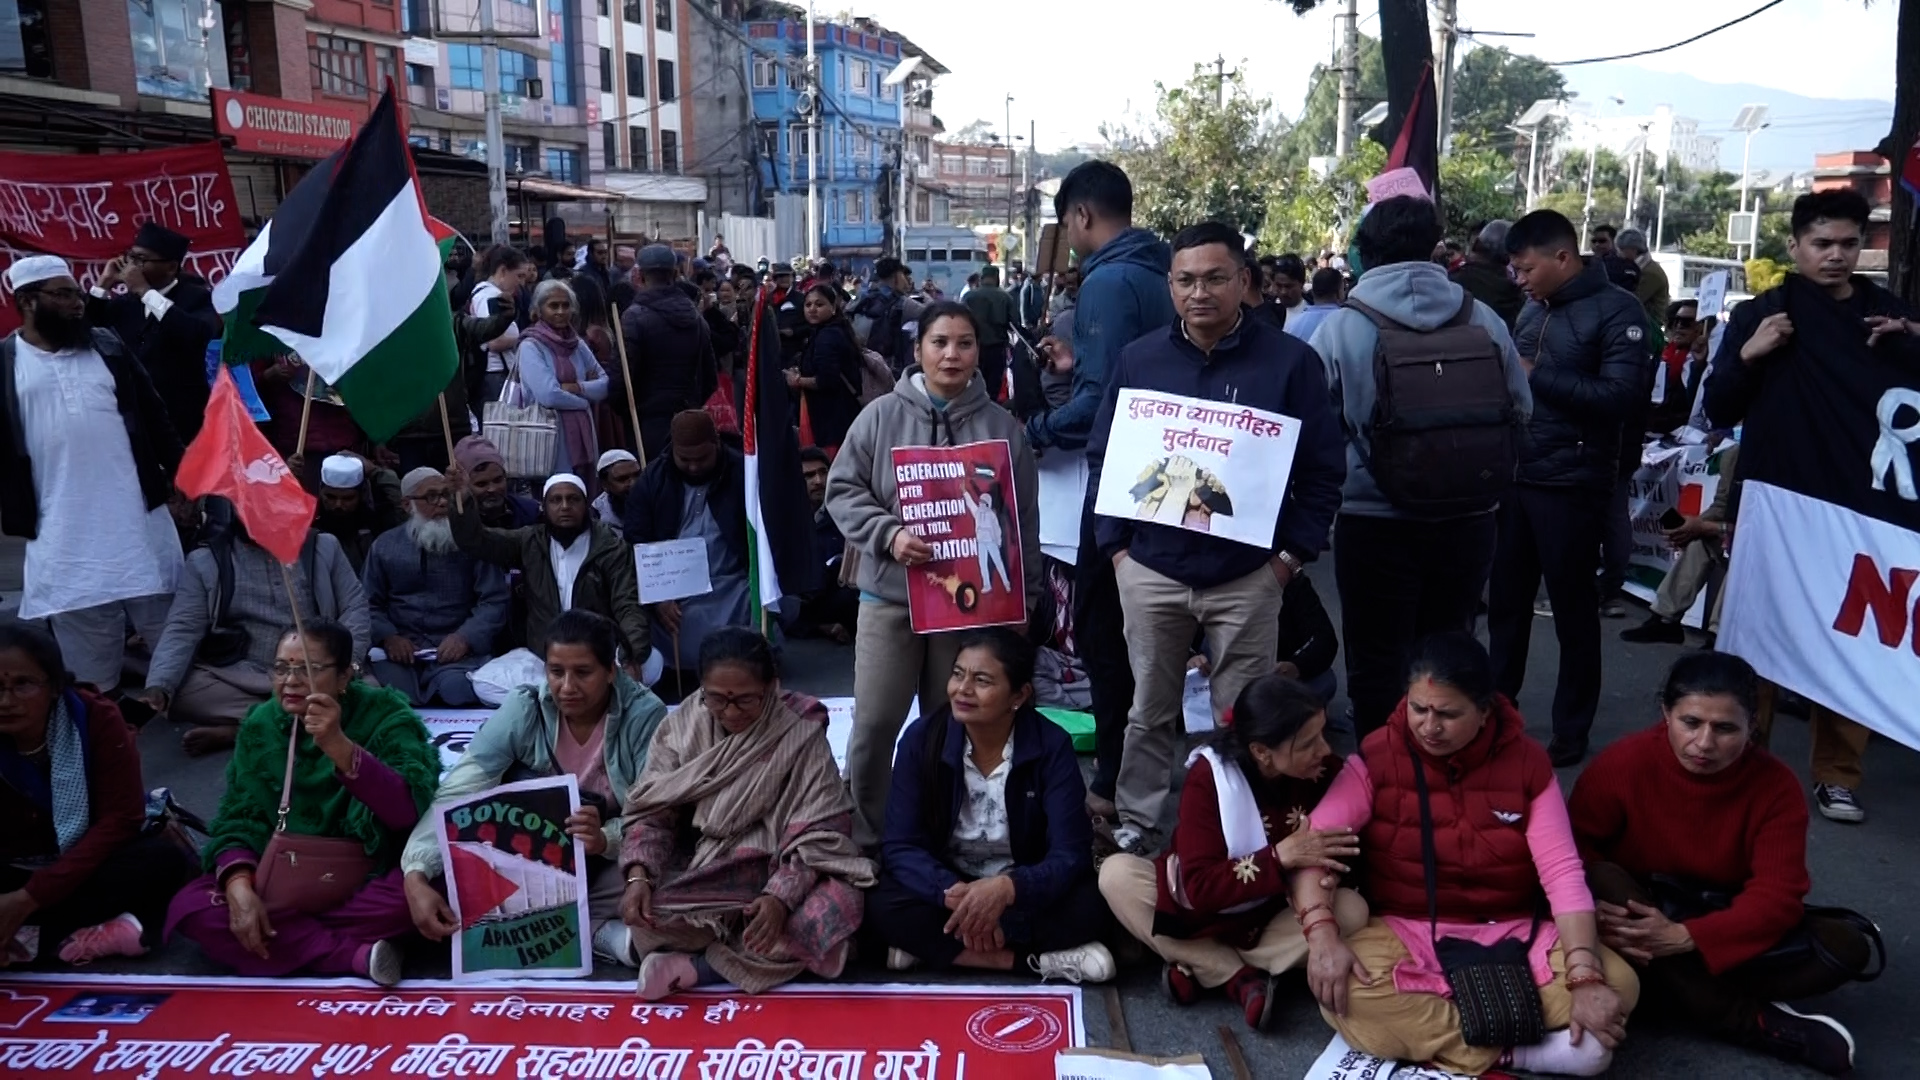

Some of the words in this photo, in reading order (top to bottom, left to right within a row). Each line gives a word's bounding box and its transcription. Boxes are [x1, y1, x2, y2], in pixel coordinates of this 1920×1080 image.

[246, 105, 303, 134] CHICKEN
[304, 113, 352, 140] STATION
[1129, 396, 1183, 418] युद्धका
[1187, 406, 1283, 438] व्यापारीहरु
[1163, 427, 1234, 457] मुर्दाबाद
[896, 461, 966, 483] GENERATION
[899, 485, 923, 499] AFTER
[902, 499, 966, 521] GENERATION
[907, 524, 927, 537] NTIL
[927, 521, 952, 535] TOTAL
[930, 537, 979, 561] RATION
[1832, 552, 1920, 658] N
[451, 801, 571, 848] BOYCOTT
[481, 913, 566, 948] APARTHEID
[516, 926, 577, 967] ISRAEL
[470, 995, 615, 1022] महिलाहरु
[631, 1003, 689, 1024] एक
[209, 1042, 323, 1077] तहमा
[390, 1033, 516, 1078] महिला
[516, 1036, 694, 1080] सहभागिता
